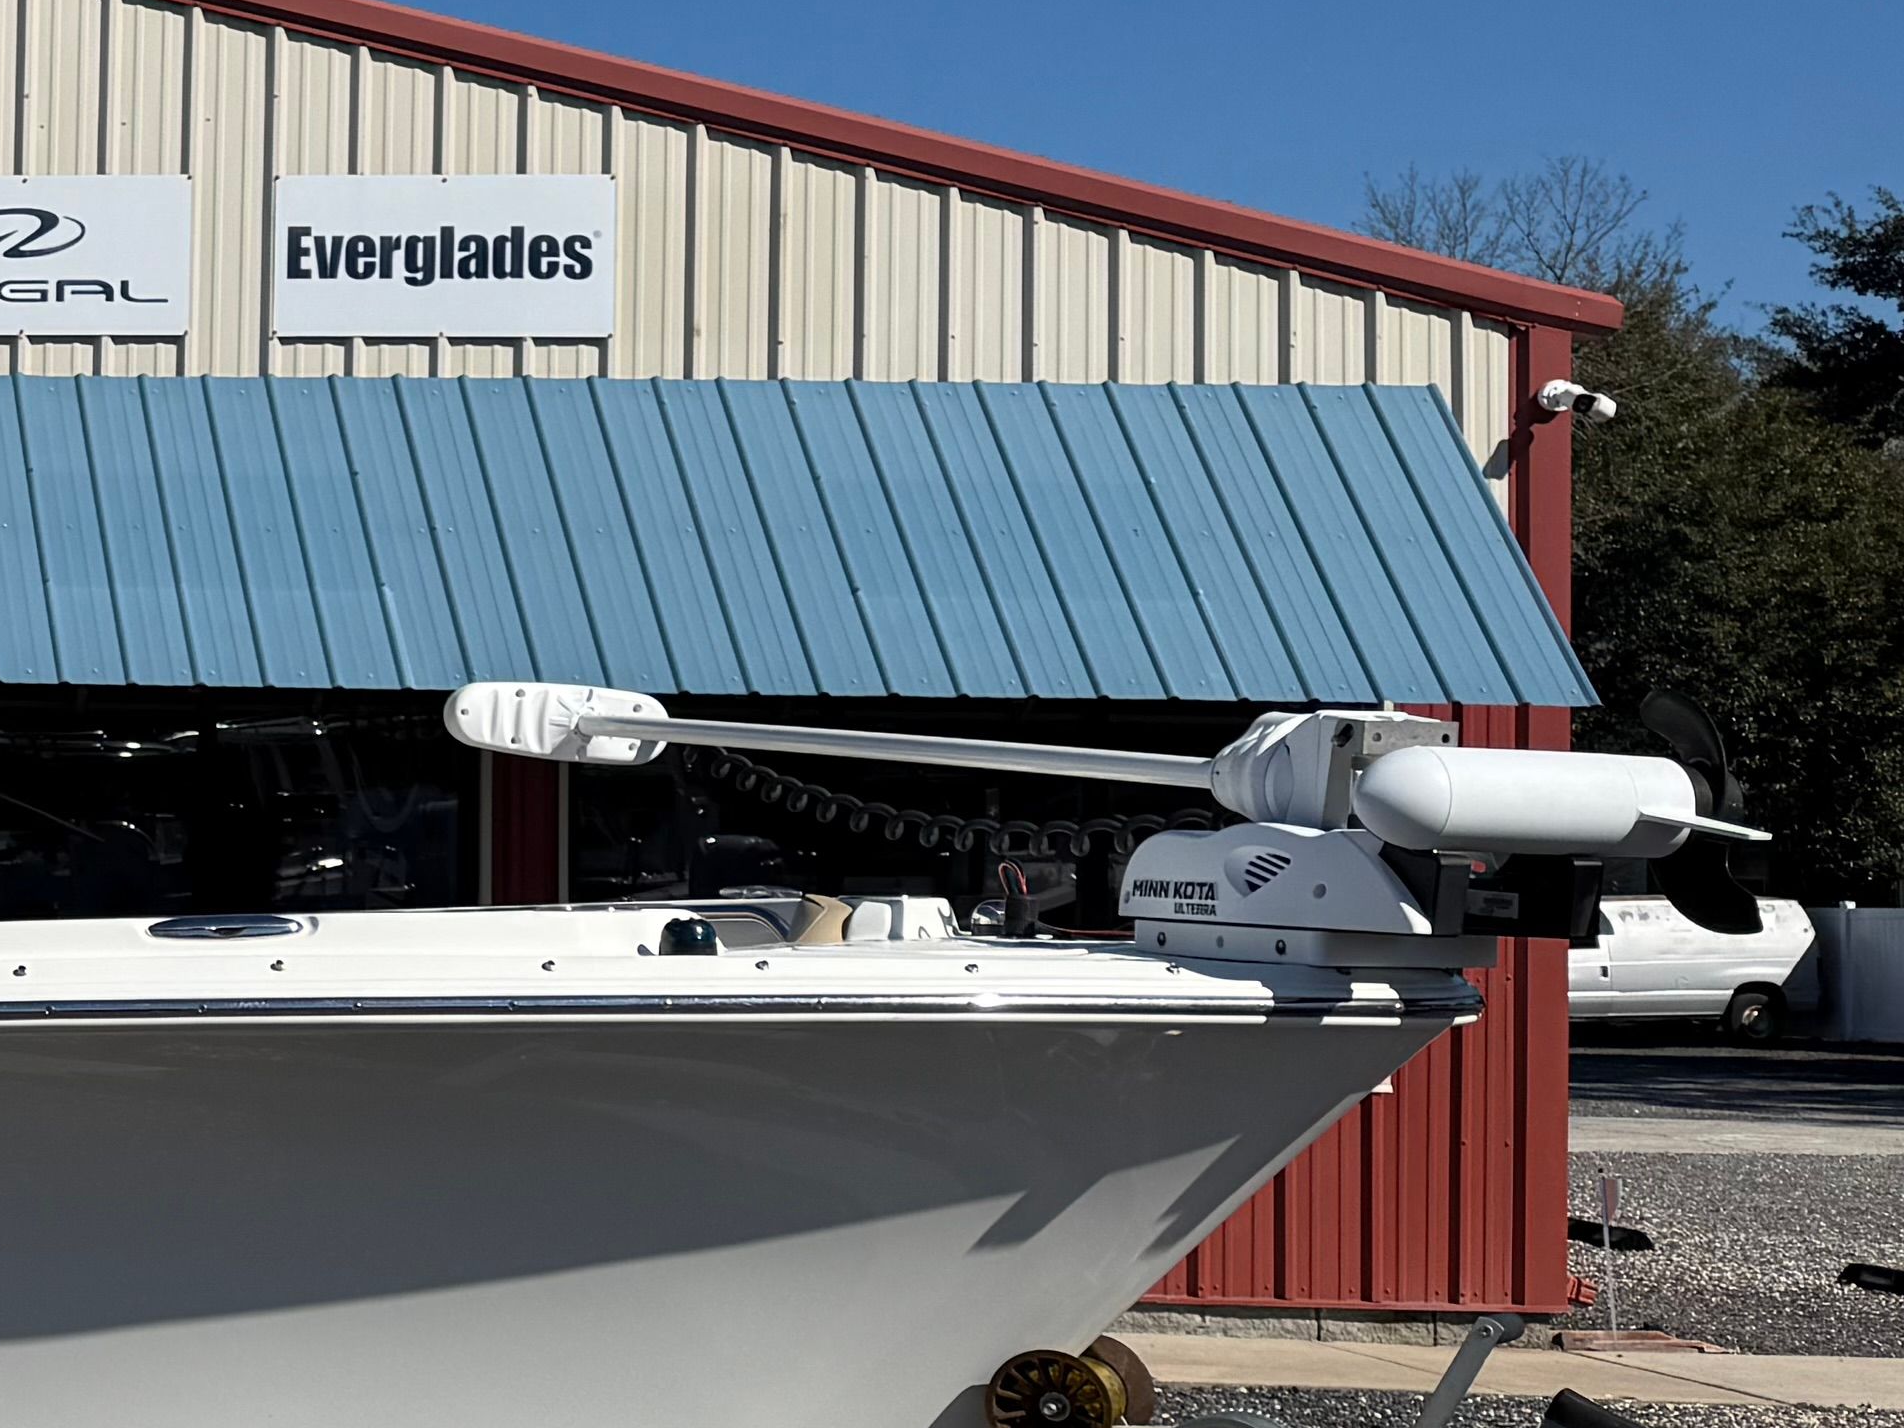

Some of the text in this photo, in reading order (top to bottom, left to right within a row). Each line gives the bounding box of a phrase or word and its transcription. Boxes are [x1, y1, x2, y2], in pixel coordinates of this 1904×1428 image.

[286, 225, 593, 287] Everglades
[1132, 879, 1217, 901] MINN KOTA
[1174, 902, 1217, 916] ULTERRA
